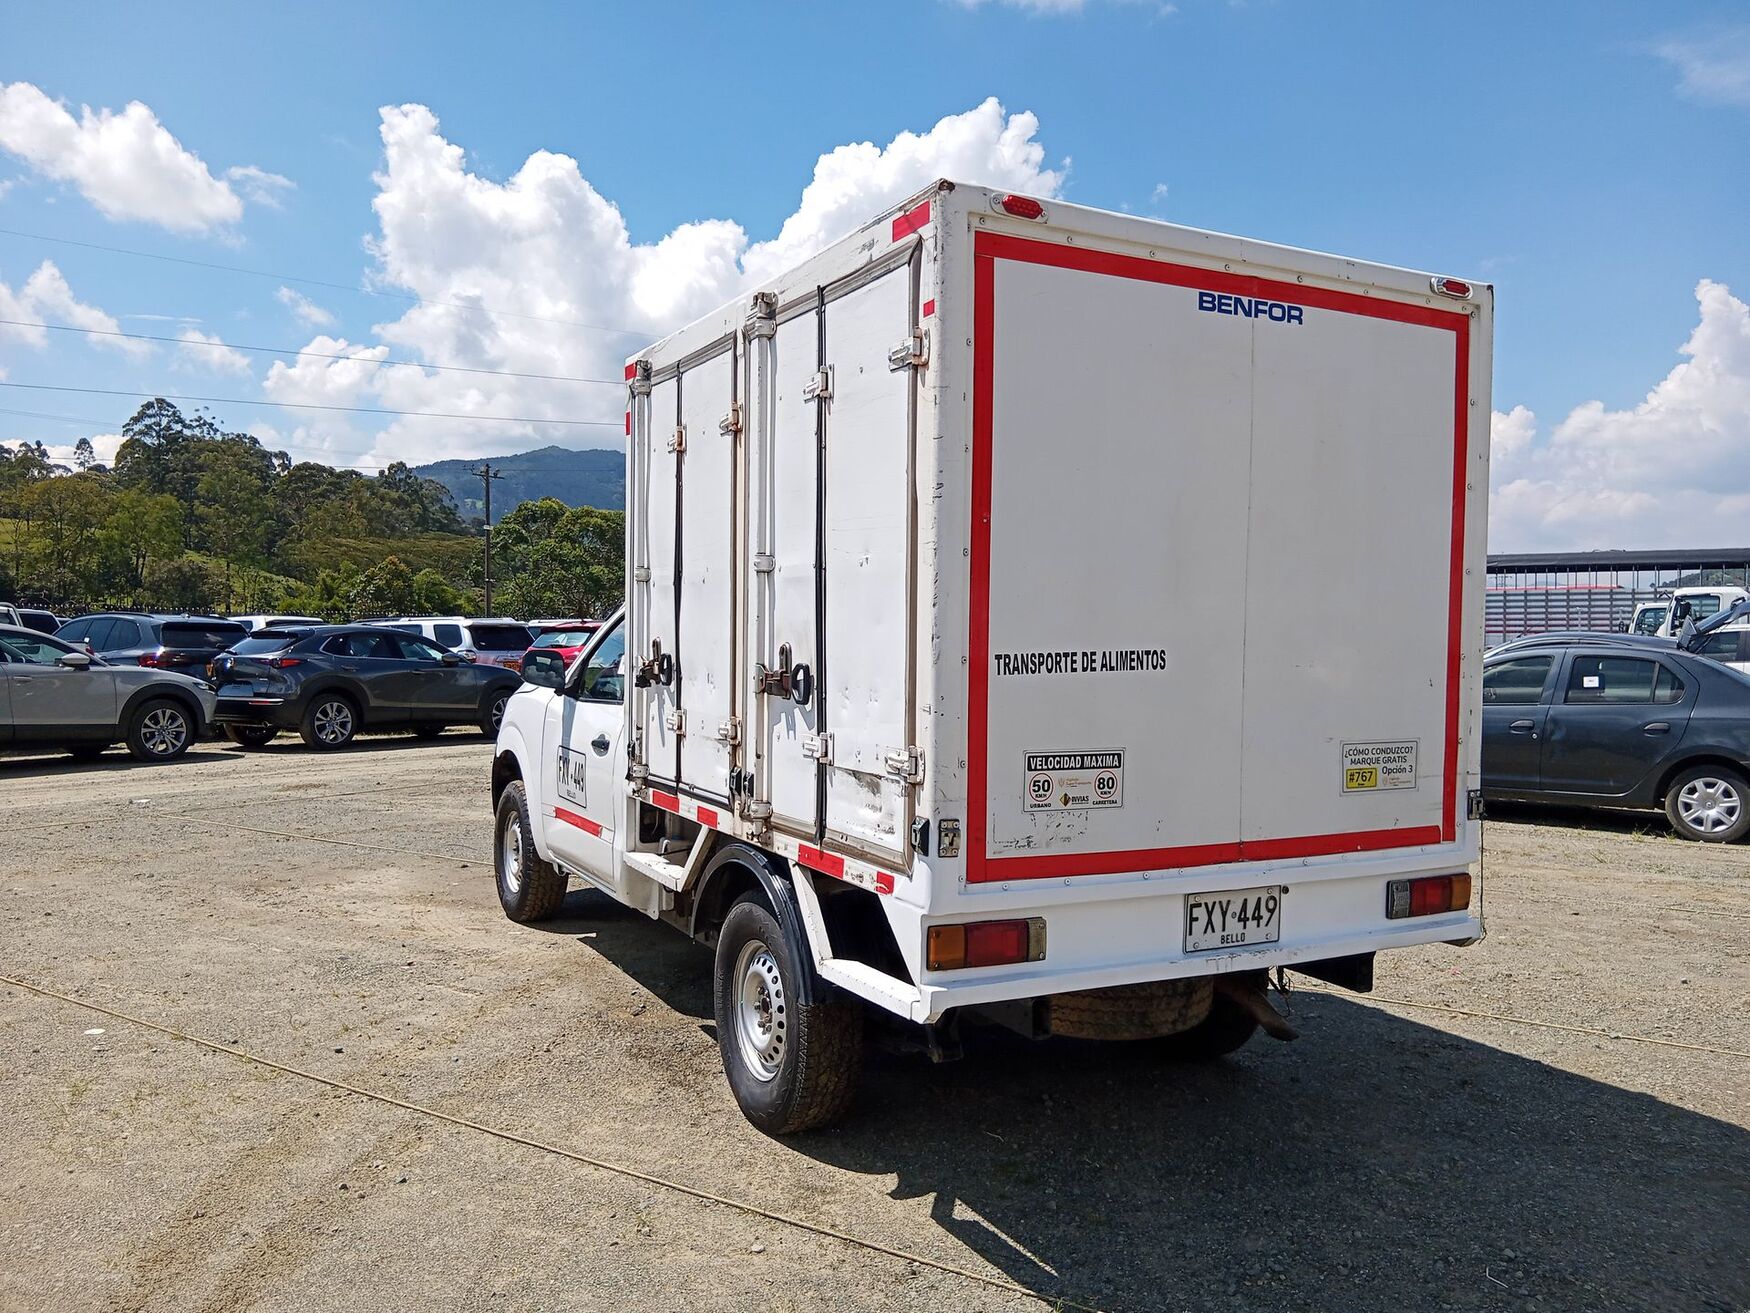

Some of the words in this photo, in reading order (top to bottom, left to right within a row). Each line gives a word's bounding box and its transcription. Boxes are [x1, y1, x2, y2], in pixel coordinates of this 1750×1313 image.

[1198, 291, 1303, 325] BENFOR
[994, 651, 1078, 676] TRANSPORTE
[1081, 651, 1097, 672] DE
[1100, 649, 1166, 672] ALIMENTOS
[1371, 746, 1413, 756] CONDUZCO?
[1030, 756, 1081, 770] VELOCIDAD
[1083, 755, 1119, 768] MAXIMA
[1350, 757, 1380, 766] MARQUE
[1382, 756, 1407, 764] GRATIS
[1408, 765, 1413, 773] 3
[1349, 771, 1373, 782] #767
[1032, 780, 1051, 793] 50
[1097, 777, 1115, 790] 80
[1220, 933, 1246, 944] BELLO
